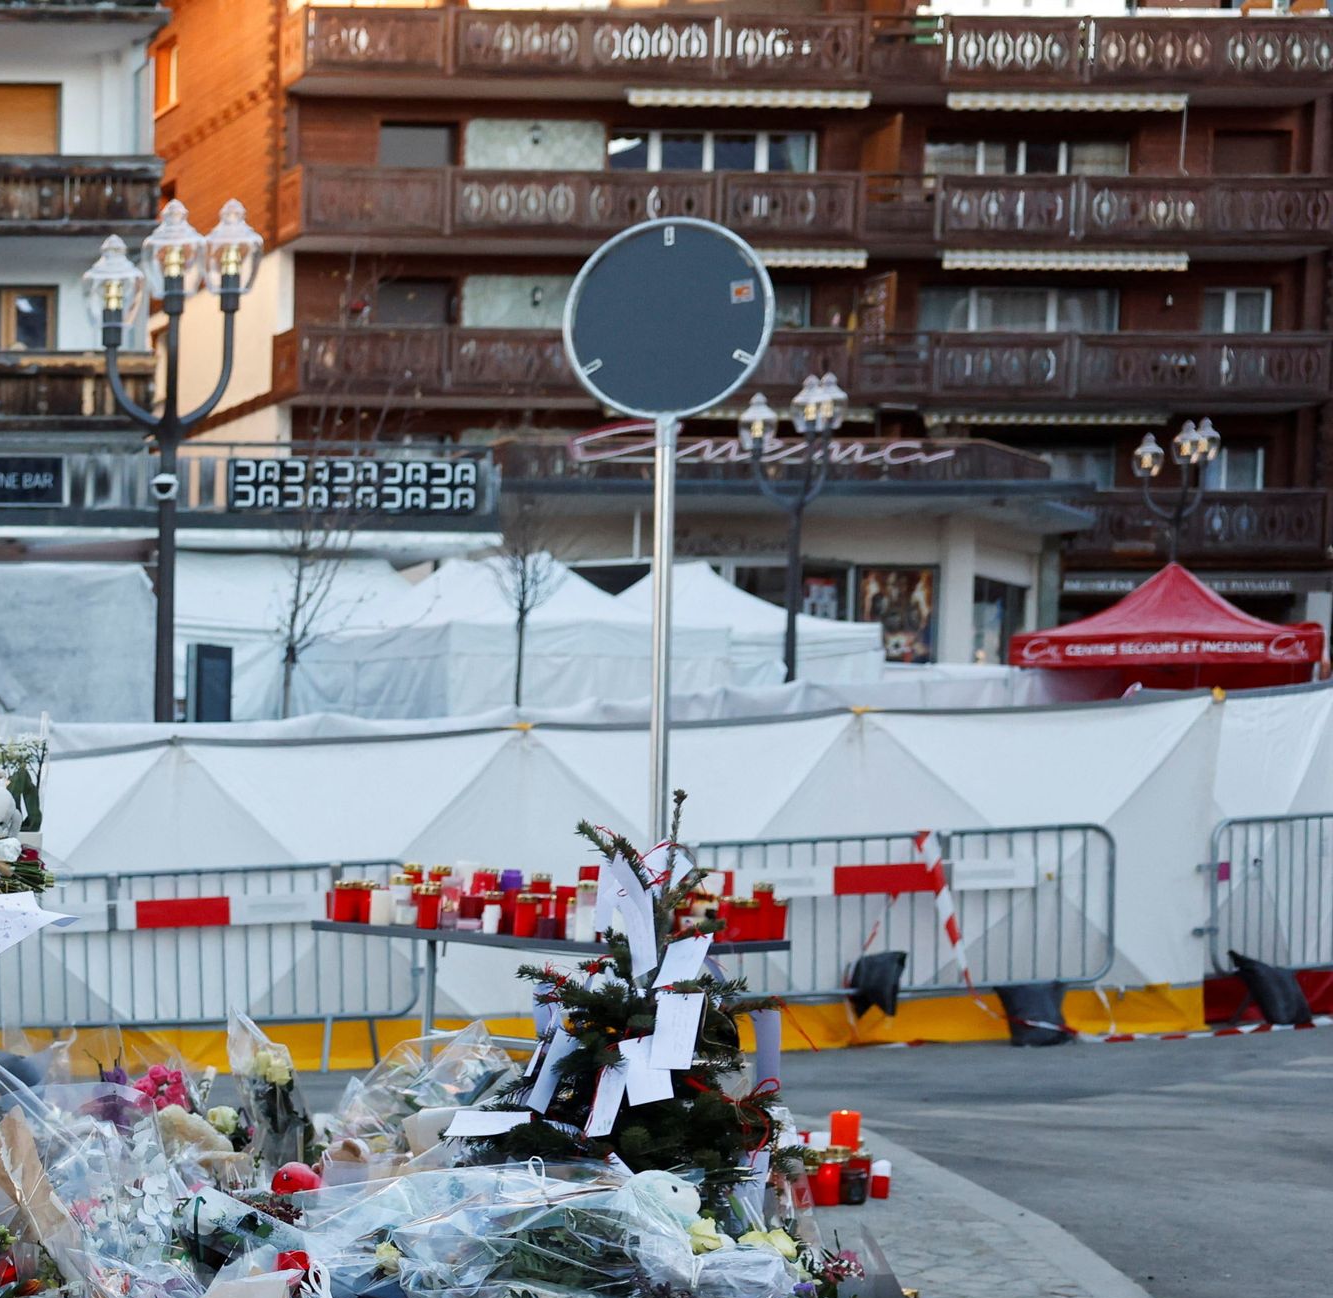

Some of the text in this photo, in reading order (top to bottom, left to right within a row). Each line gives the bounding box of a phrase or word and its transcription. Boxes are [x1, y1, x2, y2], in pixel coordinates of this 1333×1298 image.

[567, 420, 955, 462] Cnema
[22, 472, 55, 489] BAR
[1065, 644, 1117, 656] CENTRE
[1120, 642, 1179, 655] SECOURS
[1181, 642, 1199, 653] ET
[1201, 640, 1265, 653] INCENDIE
